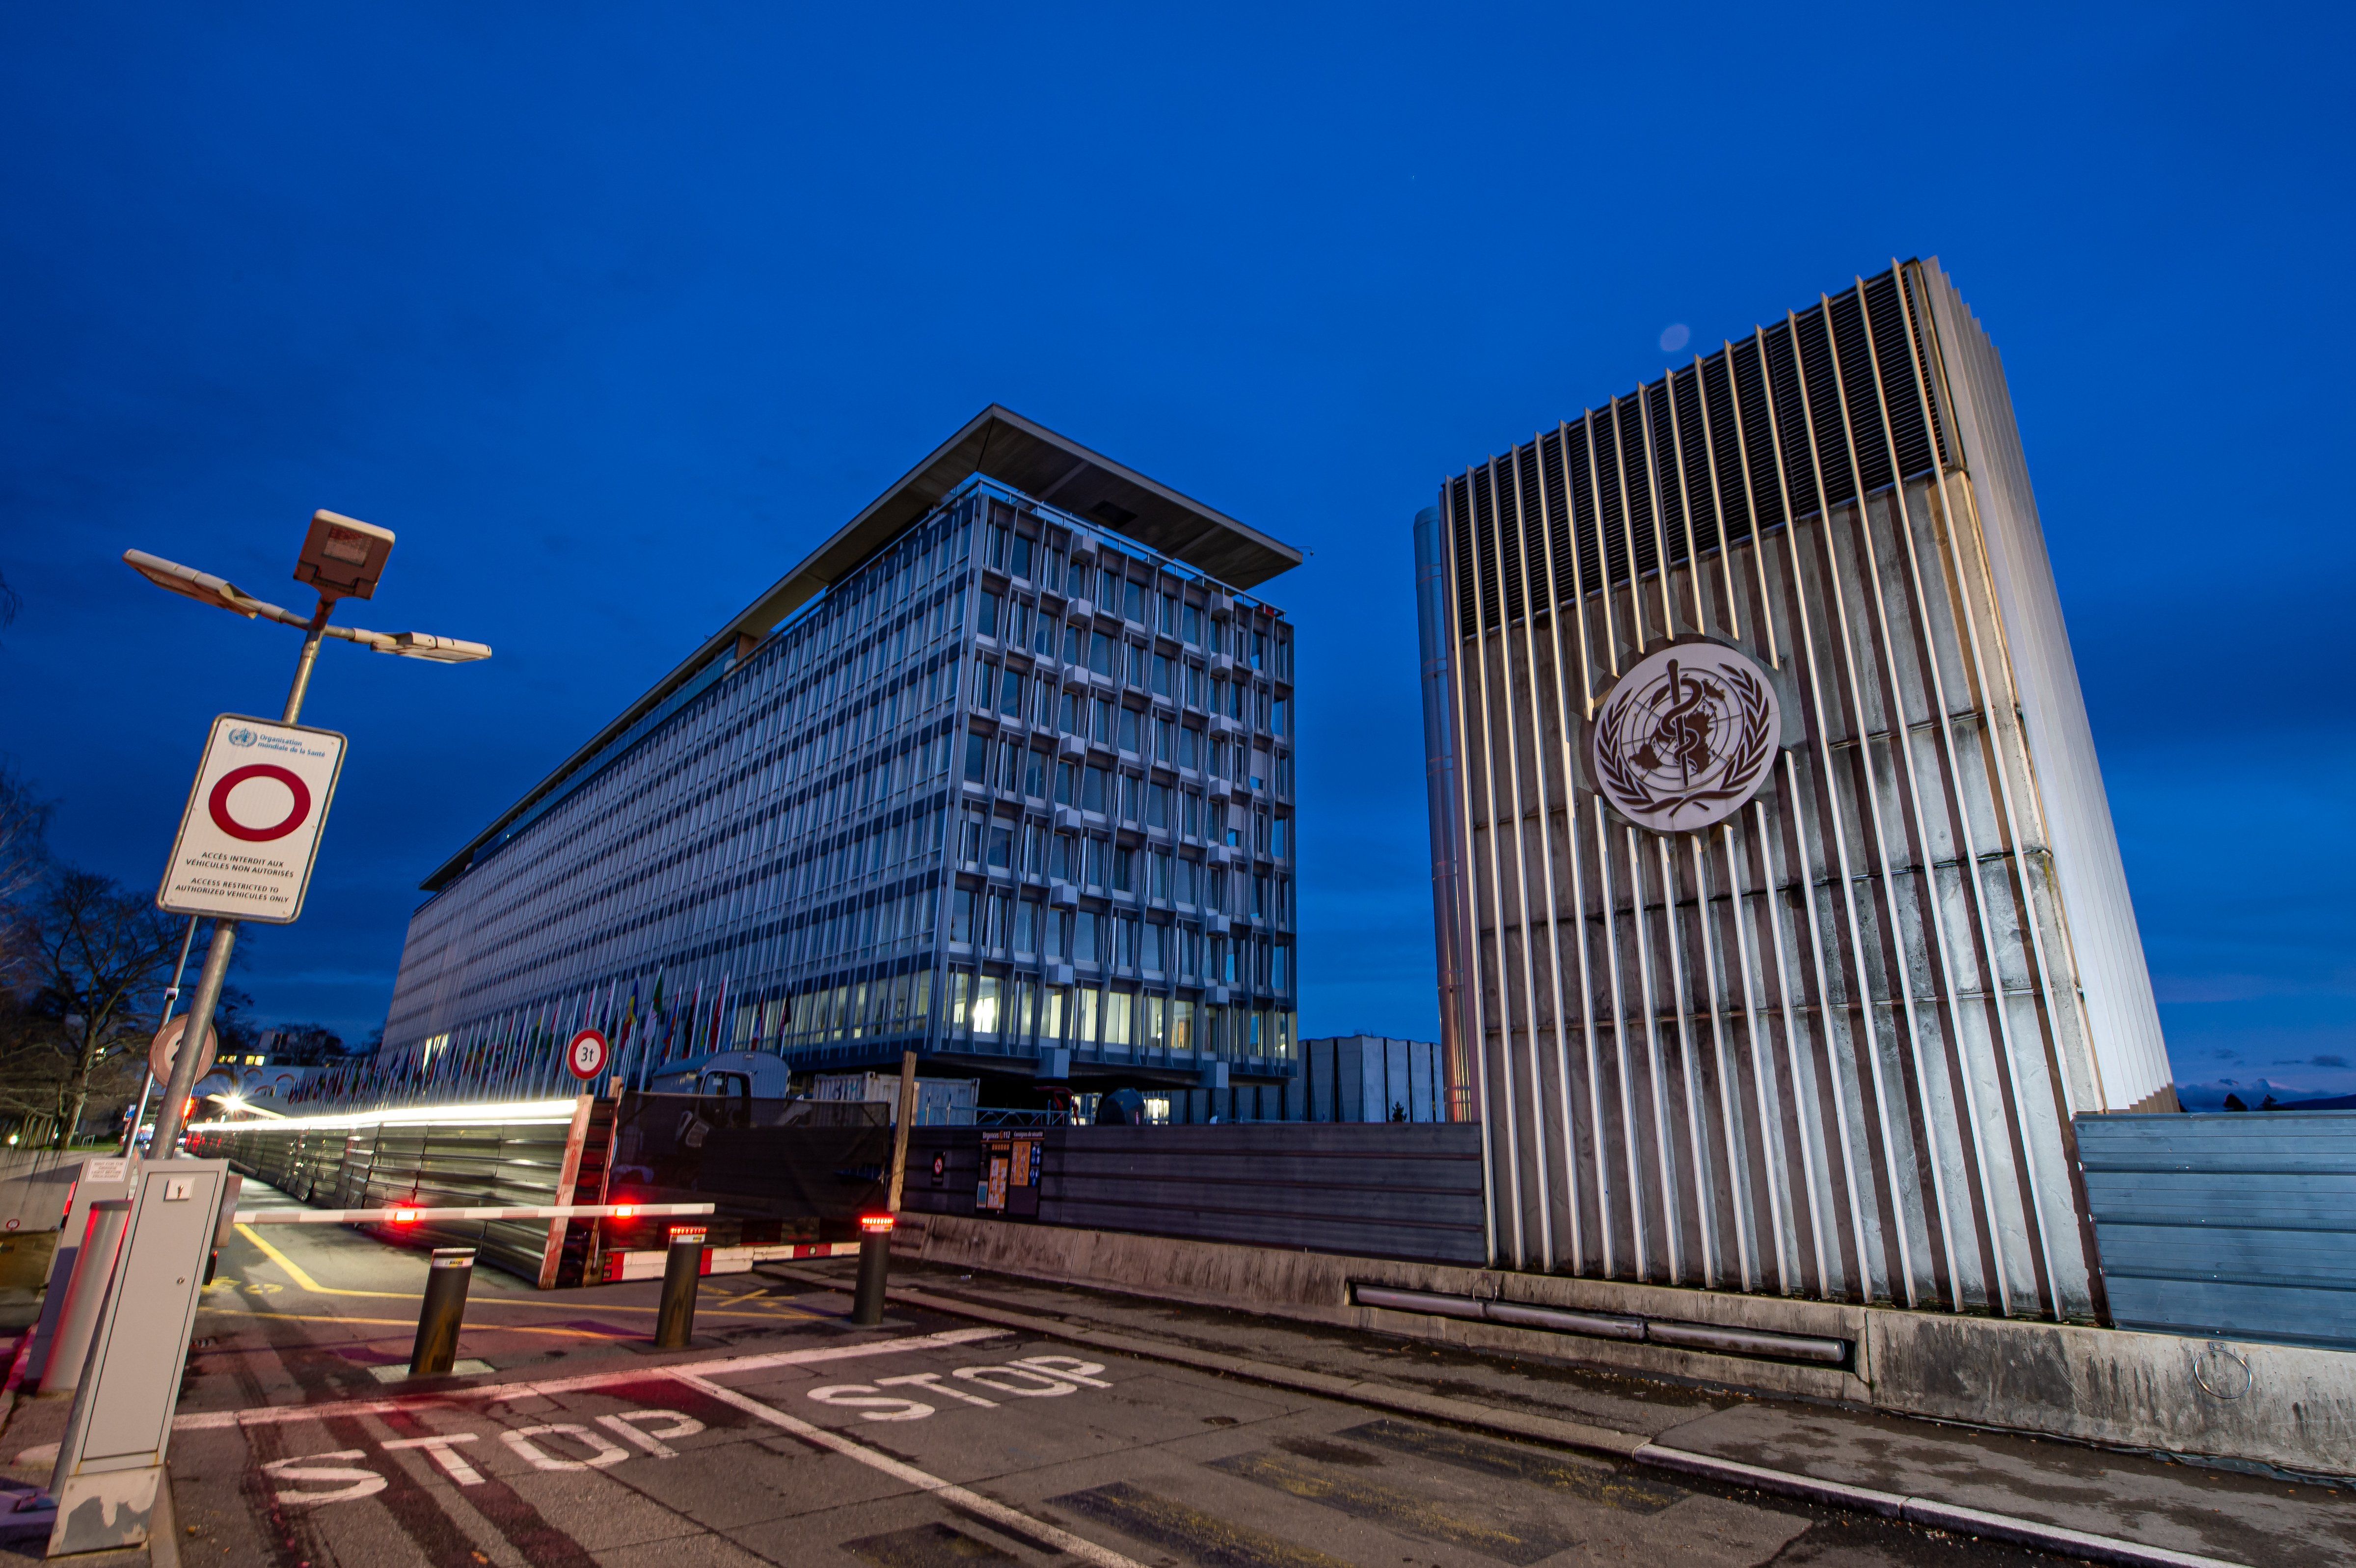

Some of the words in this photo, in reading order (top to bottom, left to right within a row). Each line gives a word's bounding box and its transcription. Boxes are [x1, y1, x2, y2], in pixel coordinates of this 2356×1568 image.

[258, 742, 288, 751] mondiale
[260, 734, 302, 746] Organisation
[202, 852, 227, 861] ACCÈS
[230, 855, 266, 866] INTERDIT
[186, 858, 229, 869] VÉHICULES
[232, 864, 250, 873] NON
[252, 865, 294, 878] AUTORISÉS
[191, 878, 221, 886] ACCESS
[223, 881, 268, 892] RESTRICTED
[175, 885, 224, 895] AUTHORIZED
[227, 890, 267, 900] VEHICULES
[581, 1047, 594, 1062] 3t
[983, 1131, 999, 1141] Urgences
[807, 1355, 1113, 1421] STOP
[261, 1409, 705, 1505] STOP
